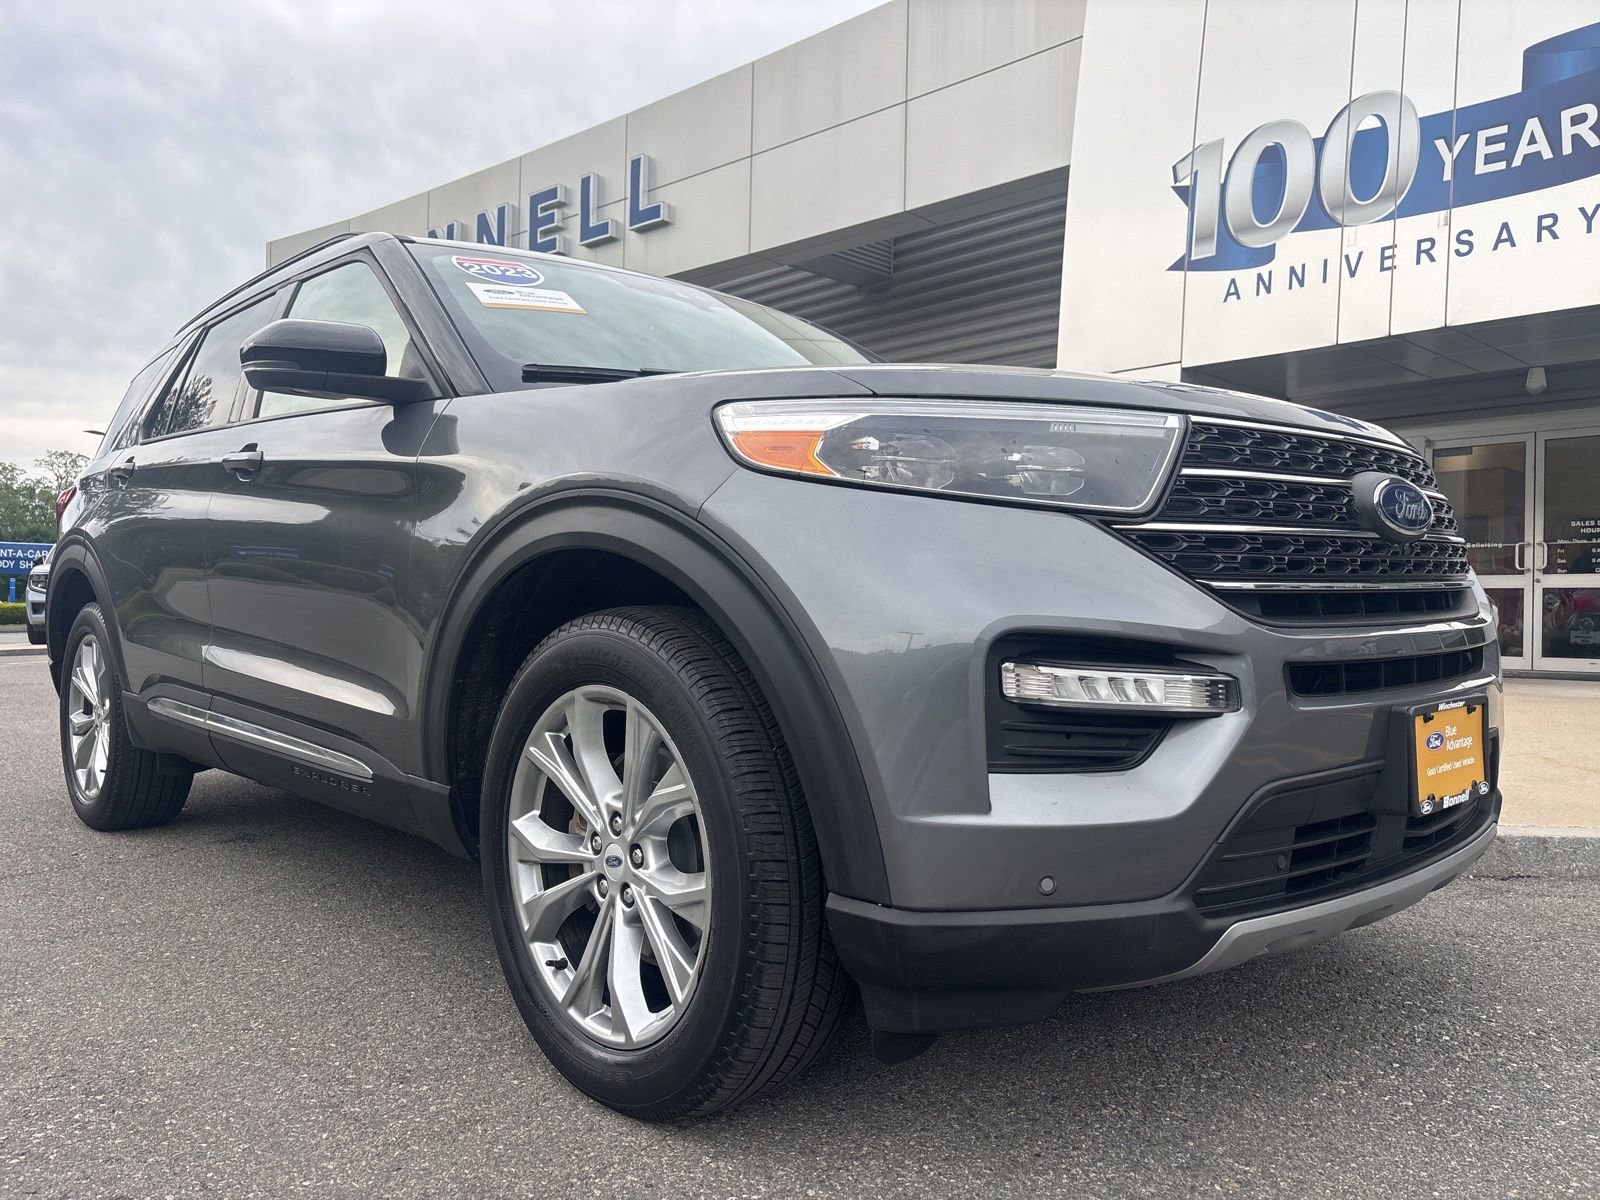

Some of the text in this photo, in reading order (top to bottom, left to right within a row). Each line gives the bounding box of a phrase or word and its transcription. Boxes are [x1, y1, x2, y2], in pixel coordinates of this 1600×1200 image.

[1173, 90, 1420, 260] 100
[1223, 203, 1600, 303] ANNIVERSARY
[463, 262, 537, 279] 2023
[1395, 488, 1429, 520] Ford
[1438, 701, 1466, 711] Winchester
[1445, 725, 1457, 738] Blue
[1446, 736, 1473, 752] Advantage
[1443, 789, 1470, 809] Bonnell
